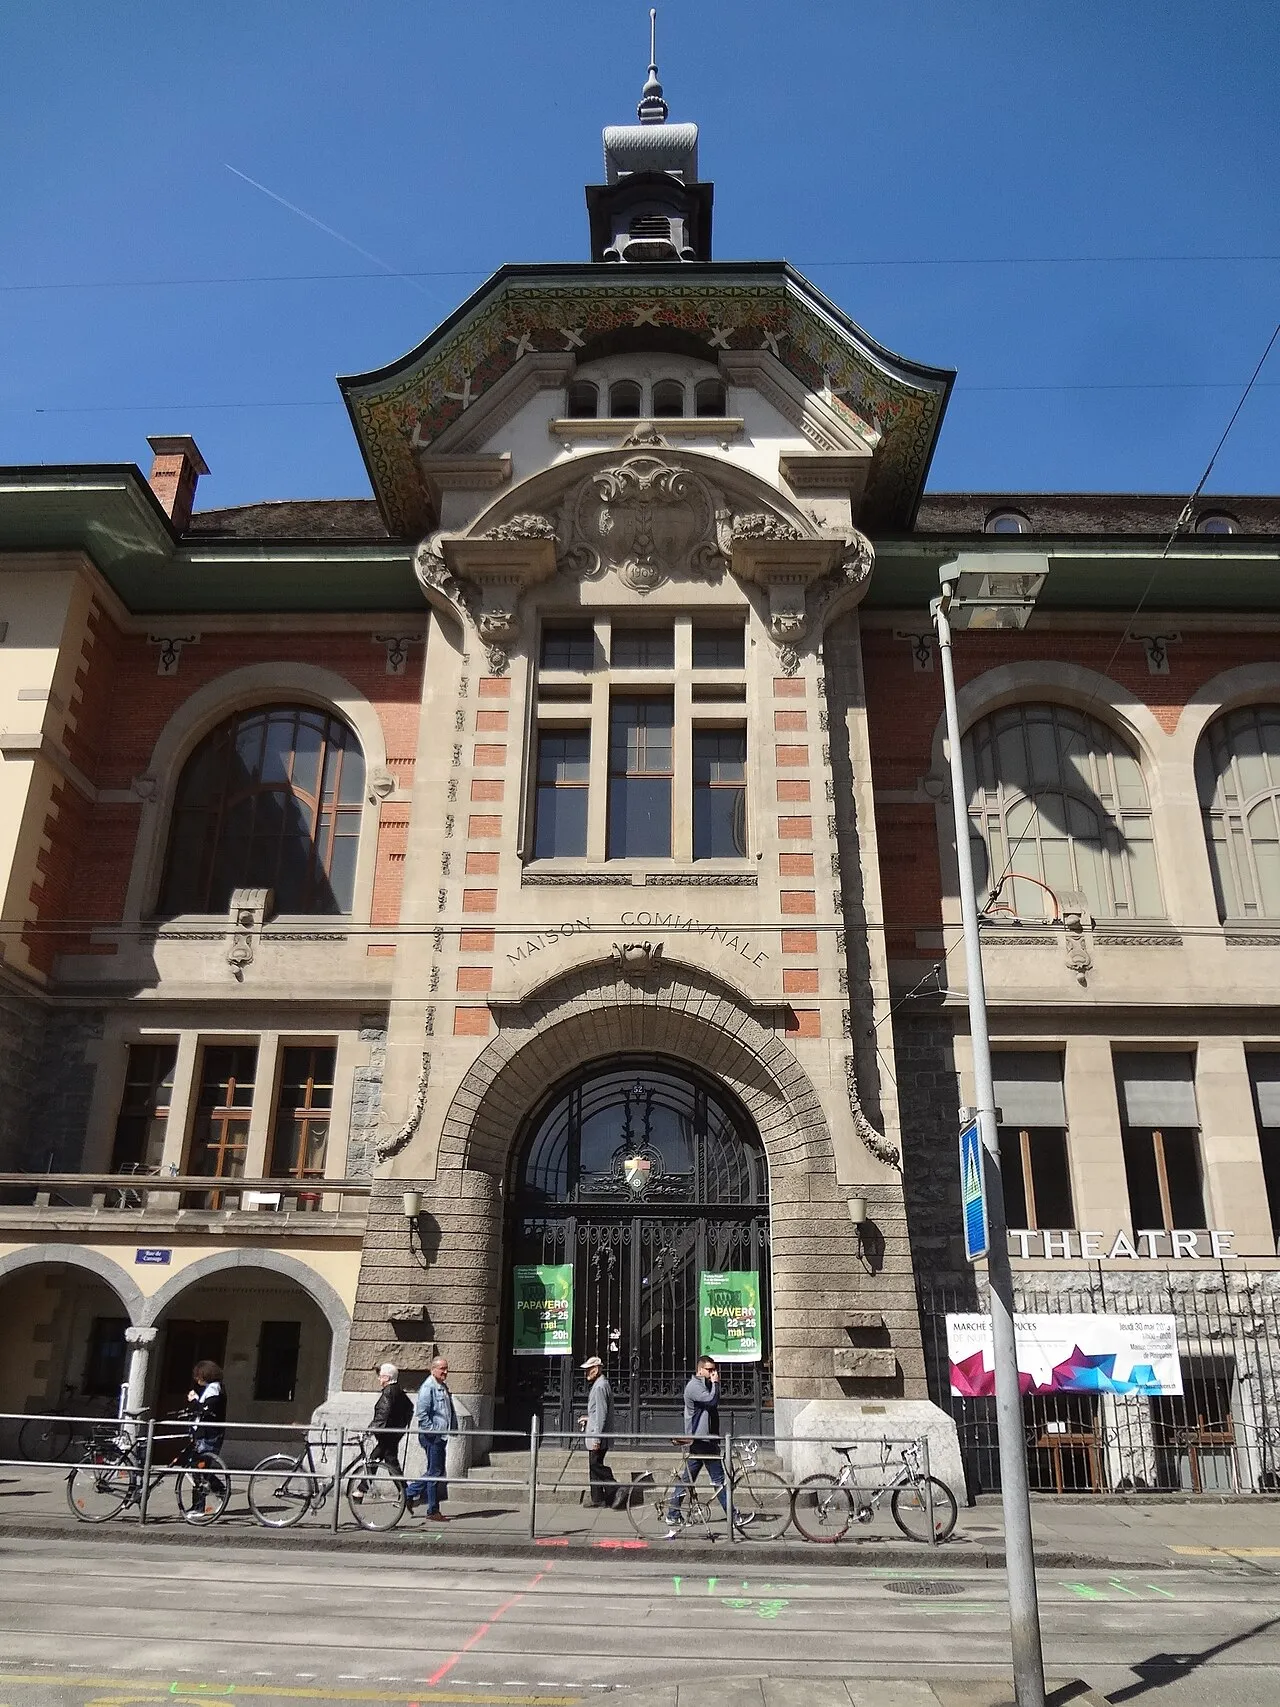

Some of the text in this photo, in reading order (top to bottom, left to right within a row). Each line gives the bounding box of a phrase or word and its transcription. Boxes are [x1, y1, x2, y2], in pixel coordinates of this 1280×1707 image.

[506, 916, 591, 967] MAISON
[1009, 1229, 1238, 1260] THEATRE
[517, 1300, 569, 1310] PAPAVERO
[540, 1311, 551, 1320] 22
[557, 1311, 569, 1320] 25
[704, 1307, 756, 1317] PAPAVERO
[541, 1321, 557, 1329] mai
[727, 1318, 739, 1328] 22
[745, 1318, 756, 1328] 25
[953, 1320, 987, 1332] MARCHÉ
[1014, 1322, 1037, 1331] PUCES
[552, 1331, 569, 1340] 20h
[728, 1328, 744, 1337] mai
[741, 1338, 757, 1347] 20h
